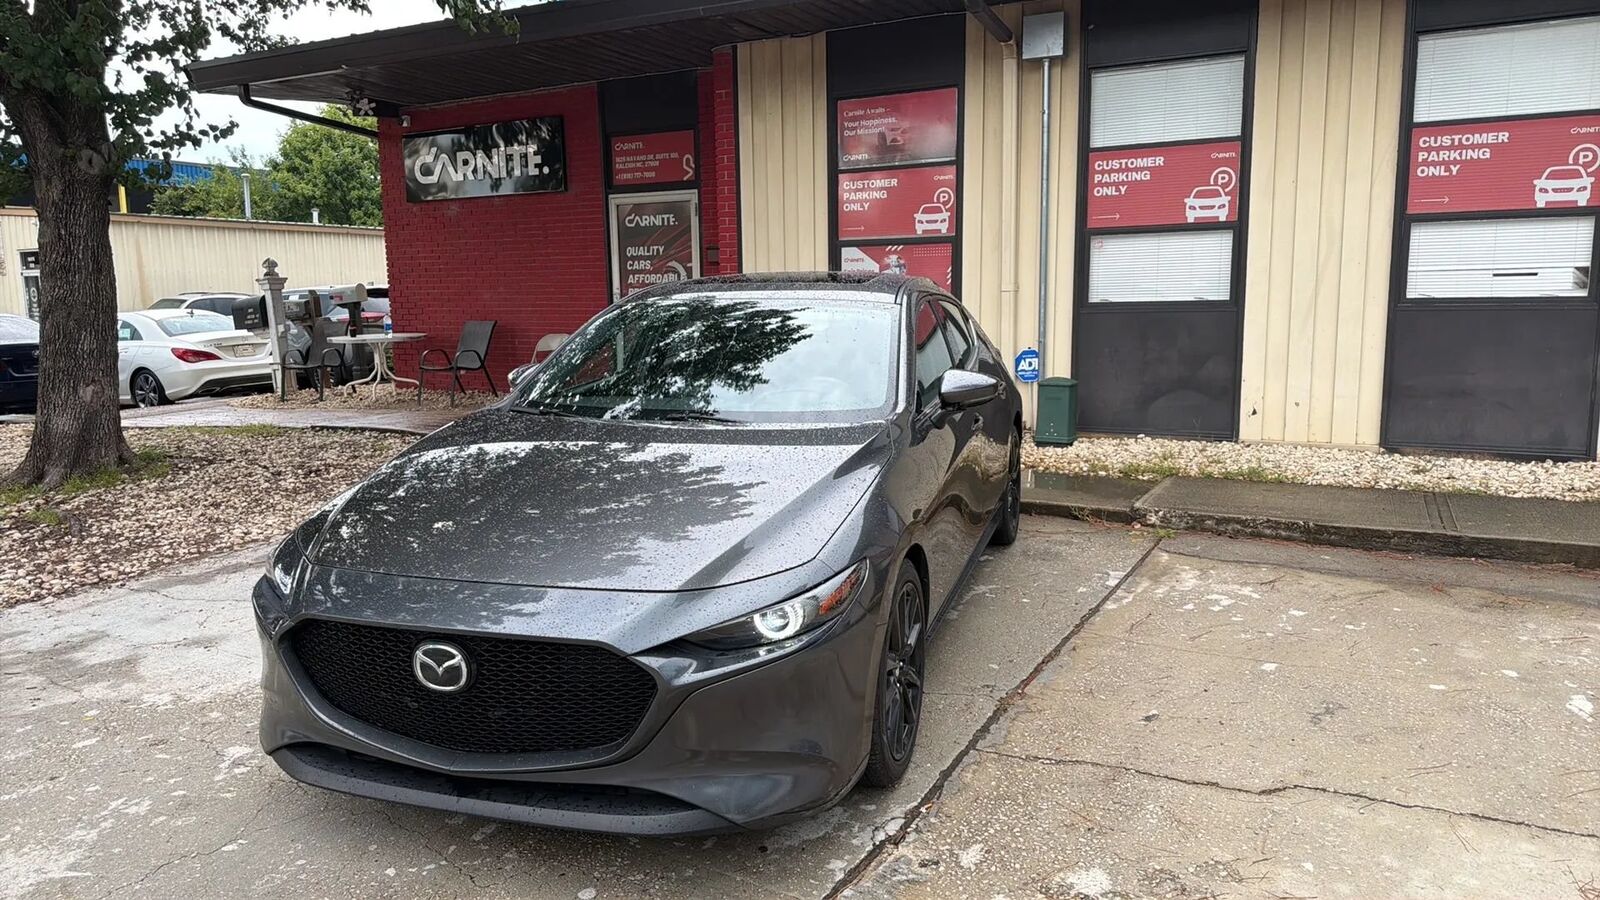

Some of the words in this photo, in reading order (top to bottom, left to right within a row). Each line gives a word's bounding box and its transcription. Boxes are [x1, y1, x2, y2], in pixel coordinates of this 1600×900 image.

[843, 129, 856, 137] Our
[1570, 126, 1600, 134] CARNIT
[1418, 132, 1510, 148] CUSTOMER
[1417, 148, 1491, 163] PARKING
[1094, 156, 1164, 171] CUSTOMER
[1416, 164, 1461, 177] ONLY
[1094, 171, 1151, 184] PARKING
[843, 178, 898, 190] CUSTOMER
[843, 190, 888, 201] PARKING
[1093, 185, 1128, 197] ONLY
[843, 202, 870, 212] ONLY
[626, 245, 665, 257] QUALITY
[626, 260, 653, 271] CARS,
[1017, 358, 1039, 371] ADT
